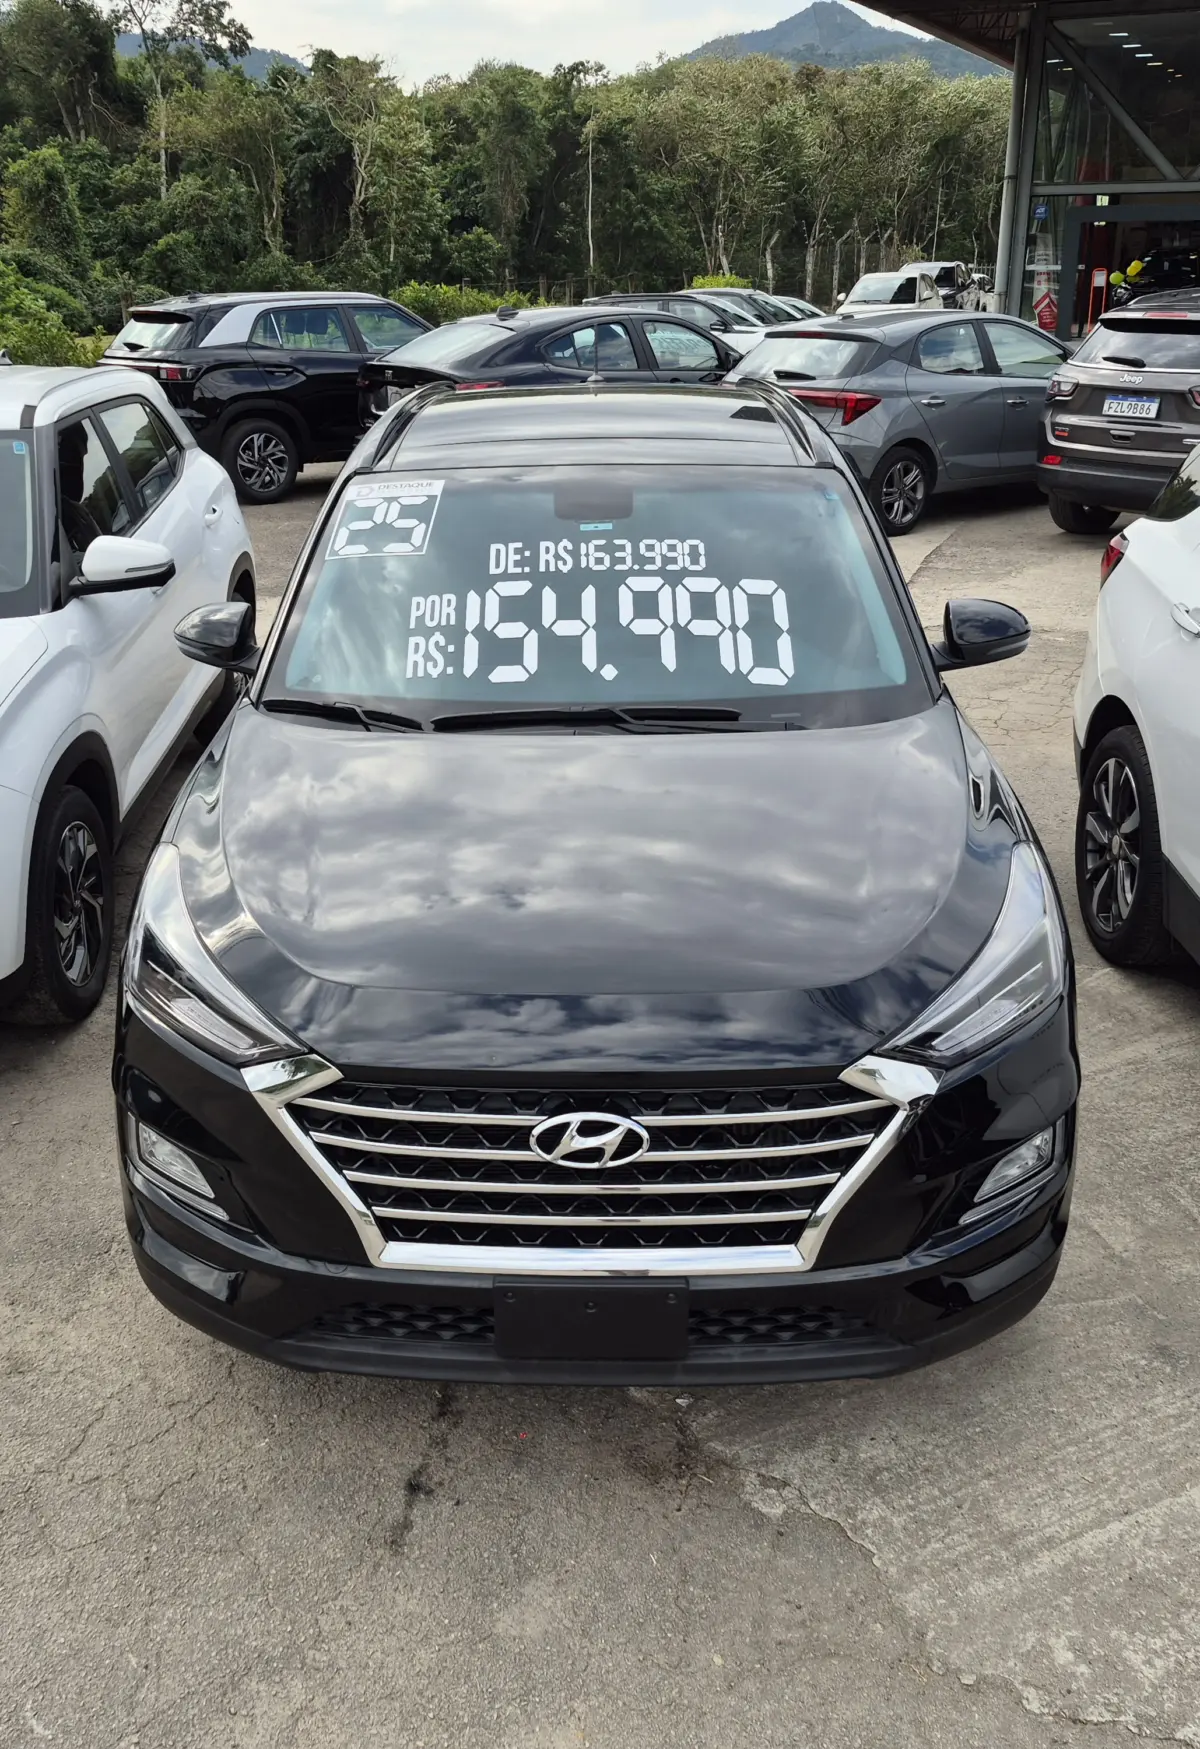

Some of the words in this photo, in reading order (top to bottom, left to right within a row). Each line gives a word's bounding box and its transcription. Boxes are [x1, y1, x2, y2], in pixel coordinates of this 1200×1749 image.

[1119, 373, 1143, 385] Jeep
[1107, 401, 1152, 415] FZL9B86
[378, 482, 433, 490] DESTAQUE
[333, 496, 428, 555] 25
[489, 542, 531, 575] DE:
[409, 593, 457, 629] POR
[463, 576, 795, 686] 154.990
